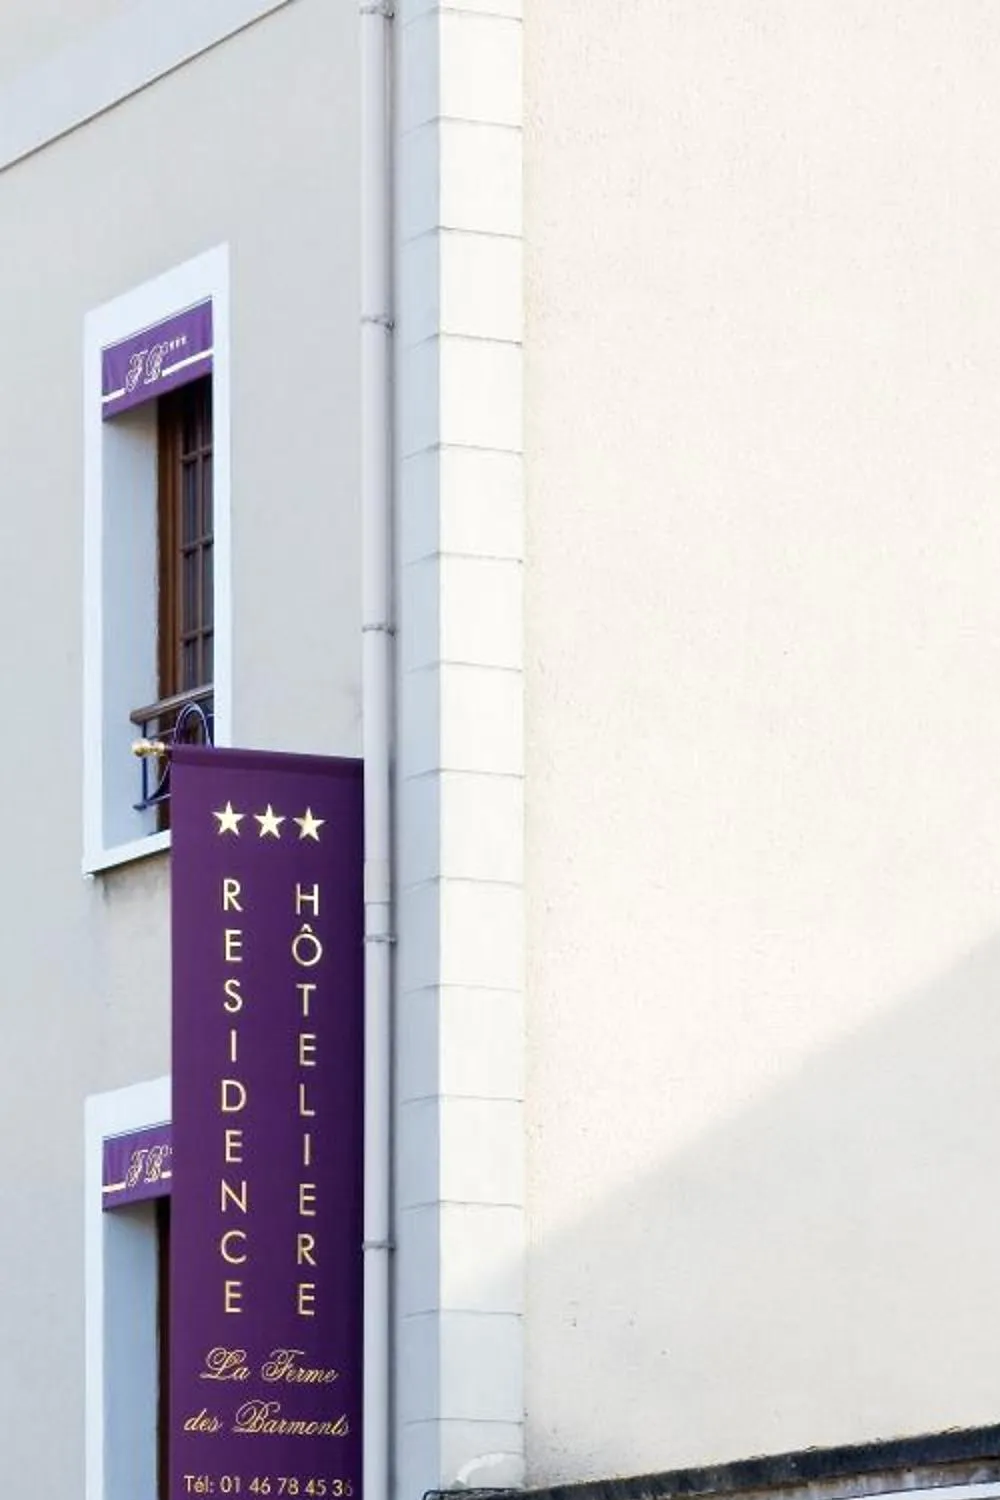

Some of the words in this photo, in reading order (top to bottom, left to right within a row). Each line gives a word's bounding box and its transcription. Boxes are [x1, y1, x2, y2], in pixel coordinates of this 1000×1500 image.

[220, 876, 248, 1314] RESIDENCE
[291, 881, 323, 1316] HÔTELIERE
[199, 1347, 250, 1381] La
[261, 1349, 339, 1383] Ferme
[183, 1407, 223, 1433] des
[232, 1399, 350, 1438] Barmonts
[184, 1475, 214, 1494] Tél:
[219, 1475, 241, 1494] 01
[249, 1477, 271, 1495] 46
[277, 1477, 299, 1496] 78
[305, 1479, 327, 1497] 45
[332, 1479, 353, 1497] 36
